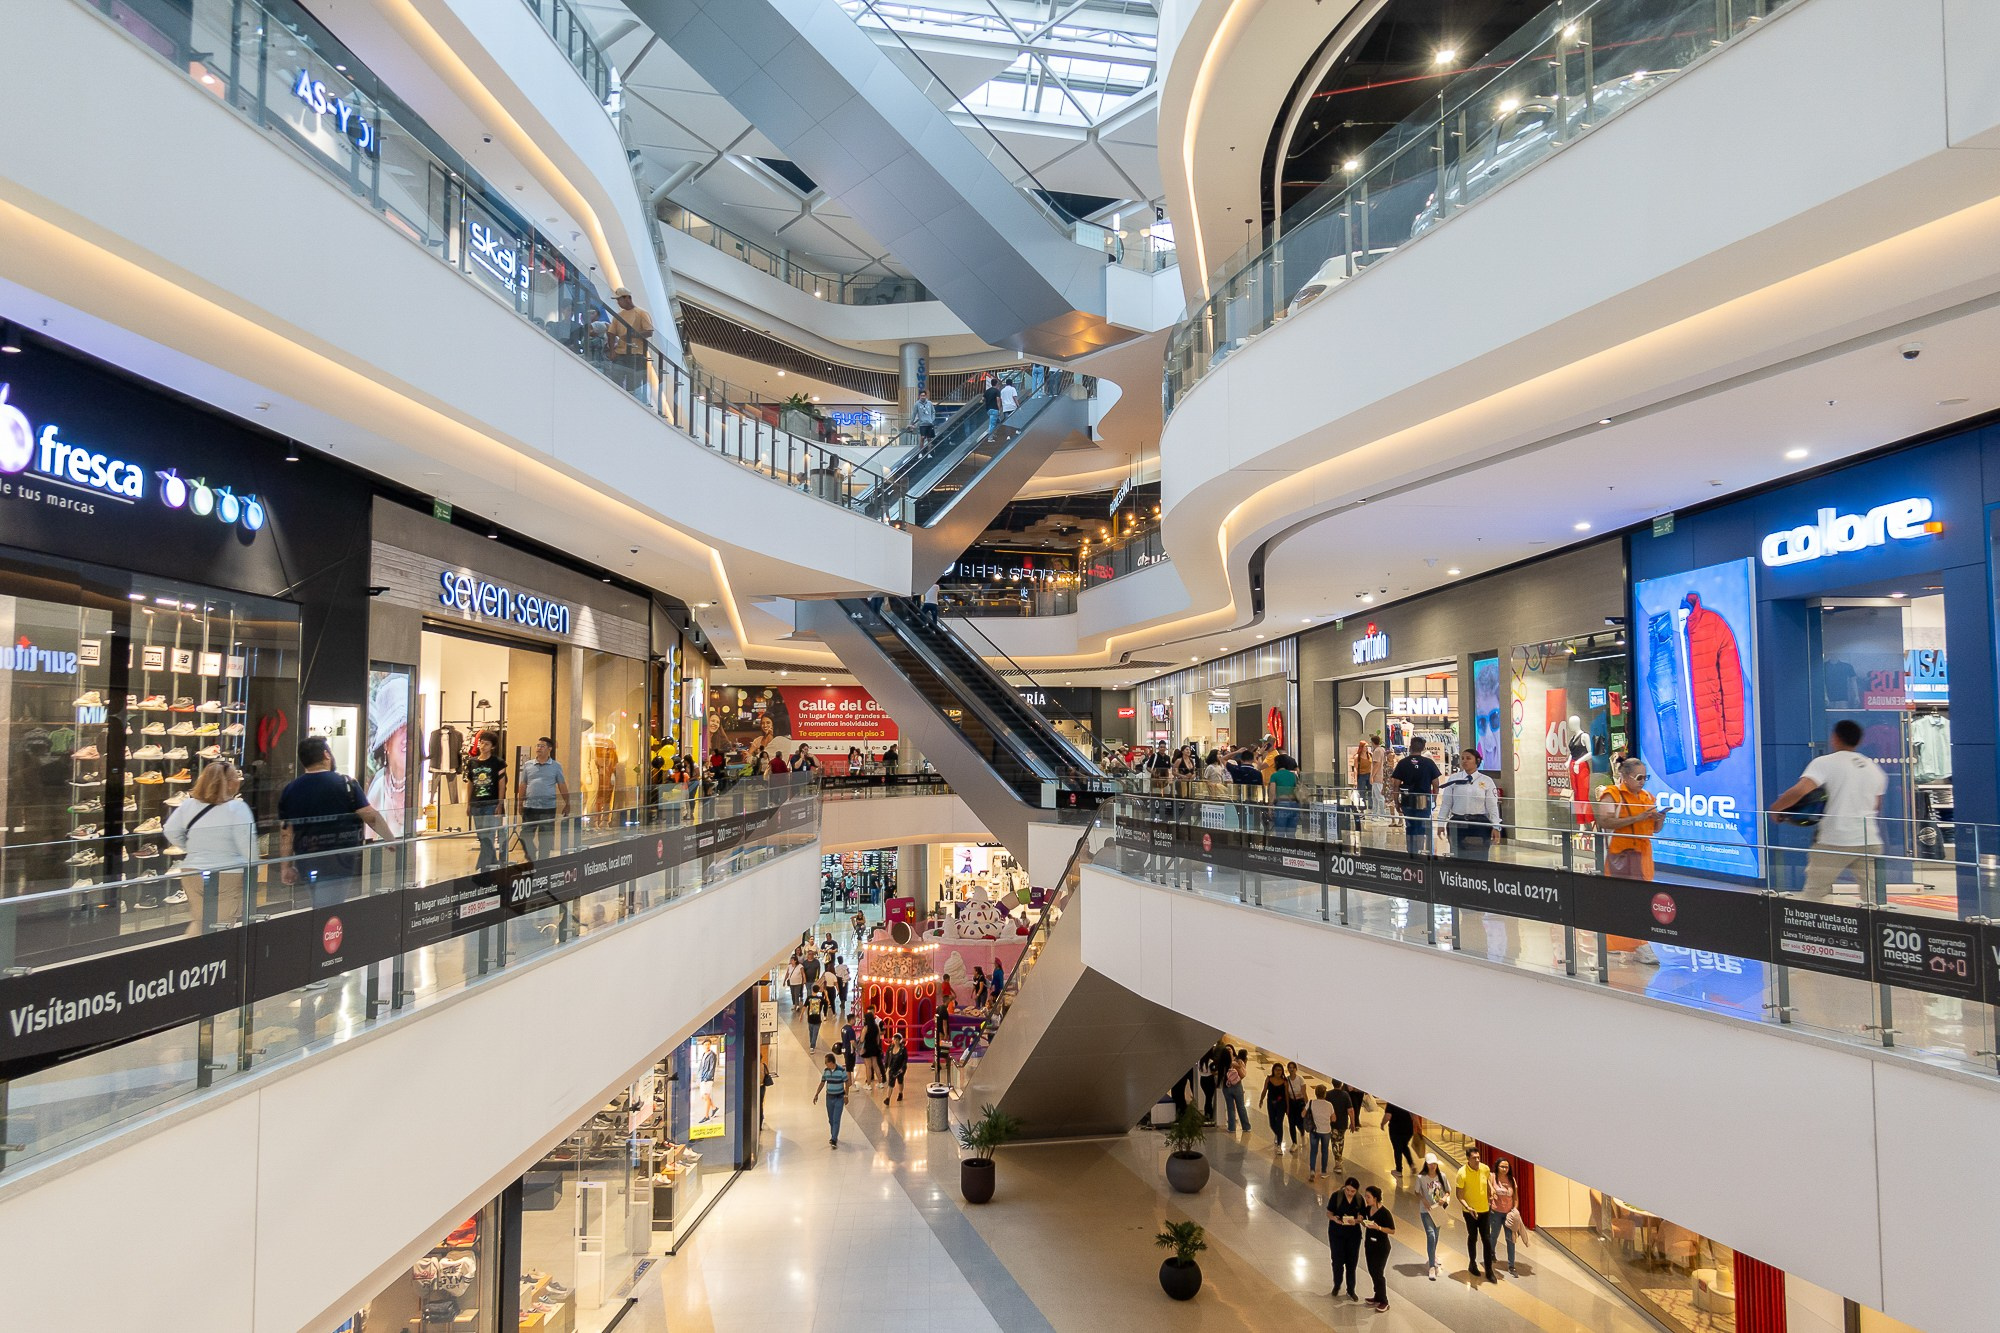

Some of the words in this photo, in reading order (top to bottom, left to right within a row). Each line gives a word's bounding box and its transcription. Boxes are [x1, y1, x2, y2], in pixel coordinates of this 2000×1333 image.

[36, 424, 144, 498] fresca
[0, 478, 12, 495] e
[18, 485, 41, 501] tus
[46, 494, 95, 515] marcas
[799, 699, 836, 712] Calle
[839, 699, 863, 712] del
[1391, 697, 1449, 715] ENIM
[864, 730, 879, 738] piso
[1681, 818, 1694, 827] BIEN
[1703, 821, 1725, 830] CUESTA
[1725, 822, 1738, 832] MÁS
[1331, 855, 1355, 876] 200
[1355, 861, 1377, 873] megas
[1380, 864, 1402, 873] comprando
[1380, 871, 1391, 880] Todo
[1391, 872, 1402, 881] Claro
[511, 876, 532, 902] 200
[532, 875, 549, 889] megas
[1439, 870, 1492, 895] Visítanos,
[1493, 878, 1522, 897] local
[1524, 884, 1559, 903] 02171
[414, 901, 422, 912] Tu
[422, 899, 437, 912] hogar
[437, 895, 451, 906] vuela
[450, 893, 460, 903] con
[459, 888, 478, 901] internet
[477, 883, 499, 896] ultraveloz
[1652, 902, 1673, 913] Claro
[1784, 907, 1795, 917] Tu
[1795, 907, 1818, 921] hogar
[1819, 913, 1842, 923] vuela
[1842, 917, 1858, 926] con
[1784, 915, 1816, 928] internet
[1817, 920, 1858, 934] ultraveloz
[1651, 926, 1667, 934] PUEDES
[1667, 928, 1678, 936] TODO
[1783, 930, 1798, 939] Lleva
[1798, 932, 1826, 944] Tripleplay
[1882, 928, 1921, 952] 200
[1928, 937, 1967, 949] comprando
[1801, 944, 1835, 957] $99.900
[1884, 948, 1923, 964] megas
[1928, 944, 1946, 955] Todo
[1946, 946, 1967, 958] Claro
[9, 990, 123, 1038] Visítanos,
[127, 969, 176, 1005] local
[178, 958, 228, 992] 02171
